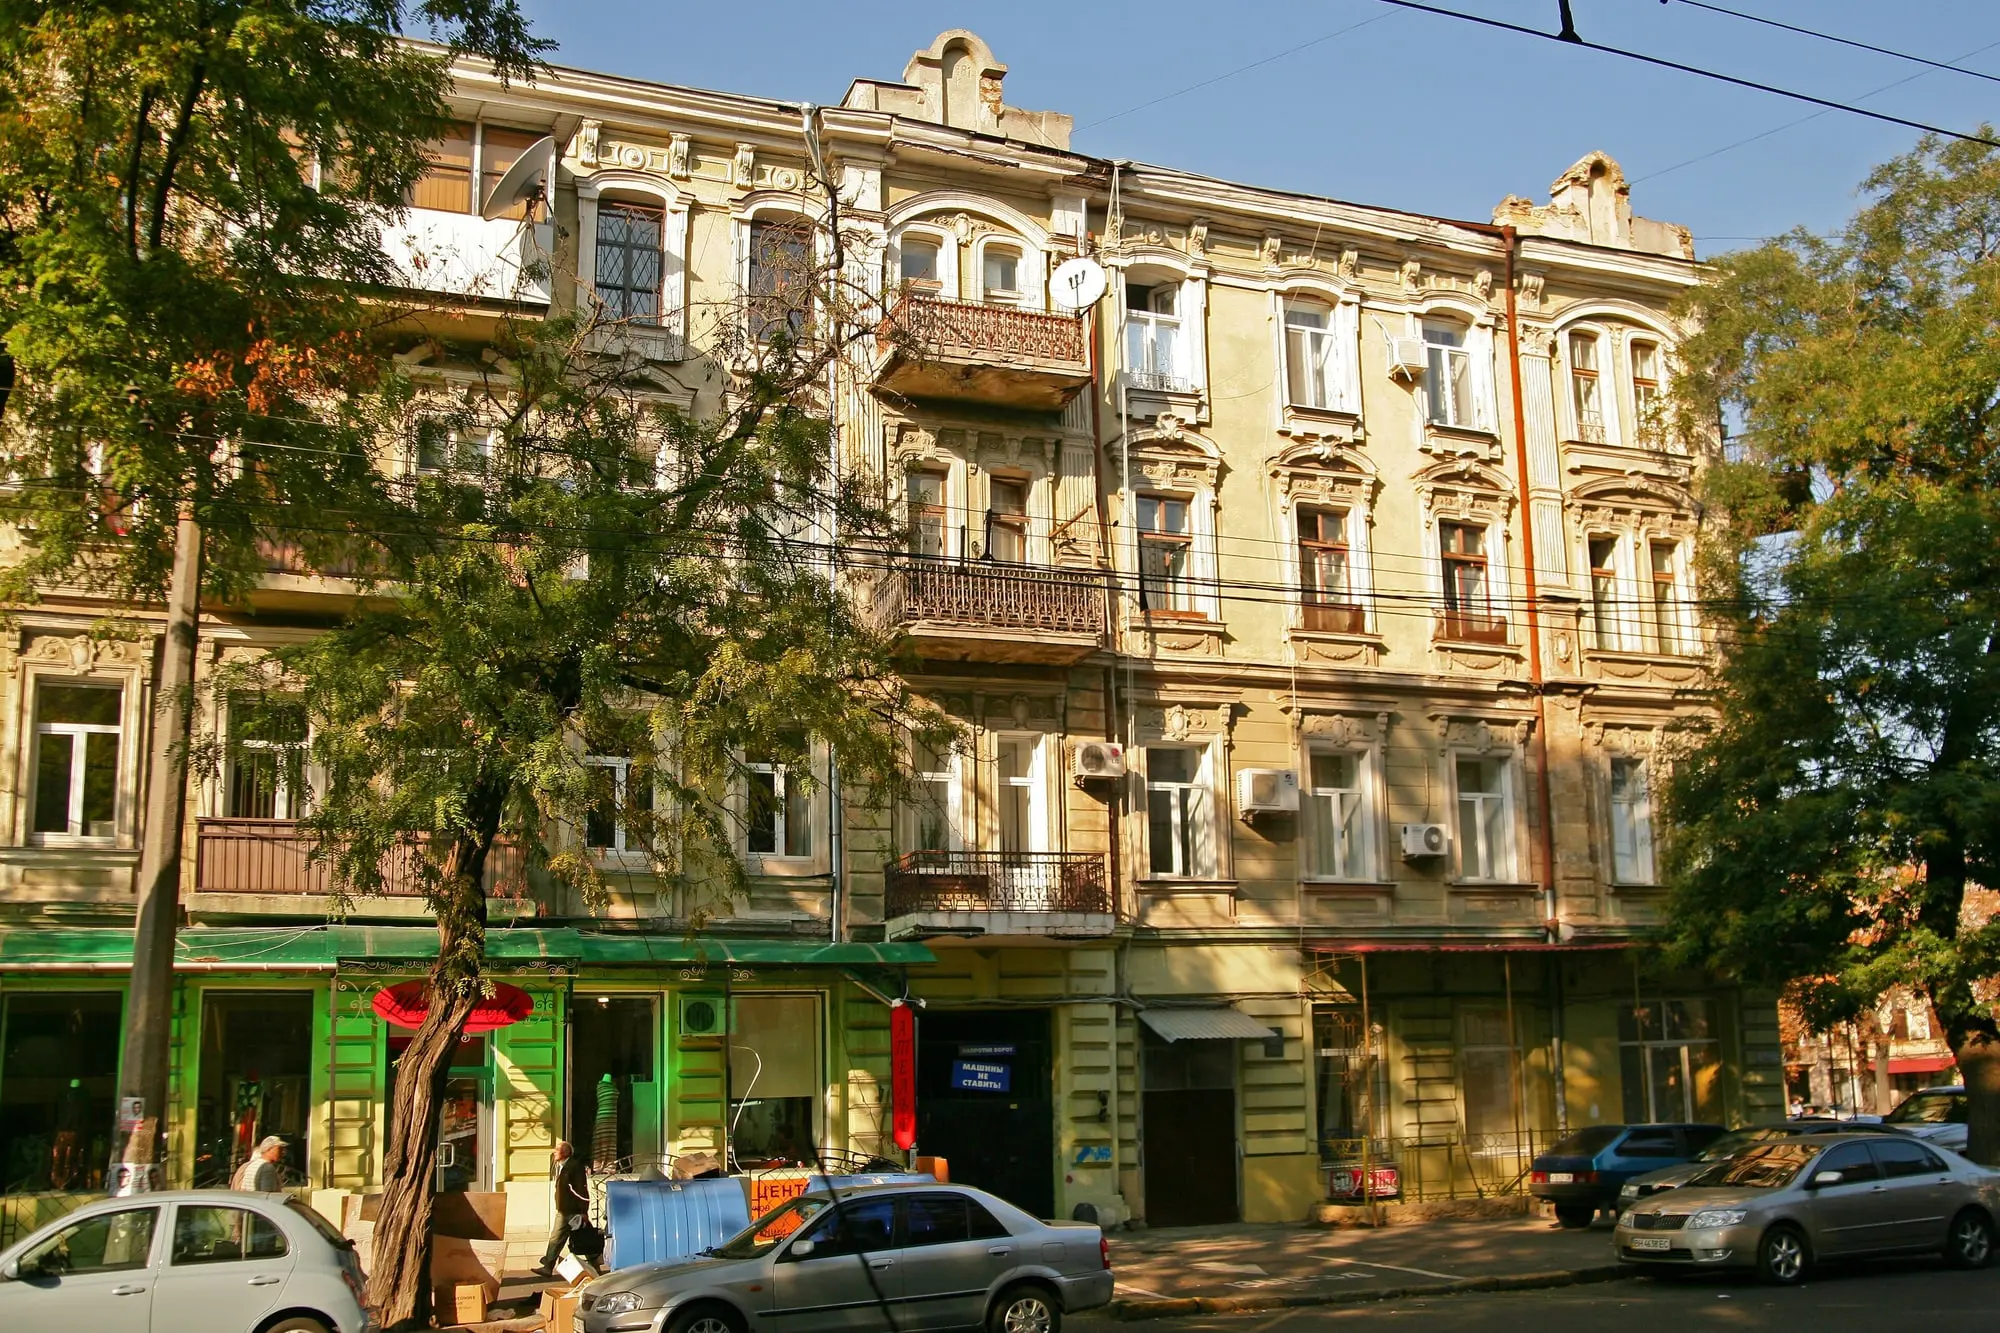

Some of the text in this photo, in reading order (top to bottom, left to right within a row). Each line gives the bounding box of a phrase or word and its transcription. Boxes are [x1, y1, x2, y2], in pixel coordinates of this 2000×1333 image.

[962, 1063, 1004, 1073] МАШИНЫ
[977, 1072, 989, 1080] НЕ
[962, 1079, 1002, 1089] СТАВИТЬ!
